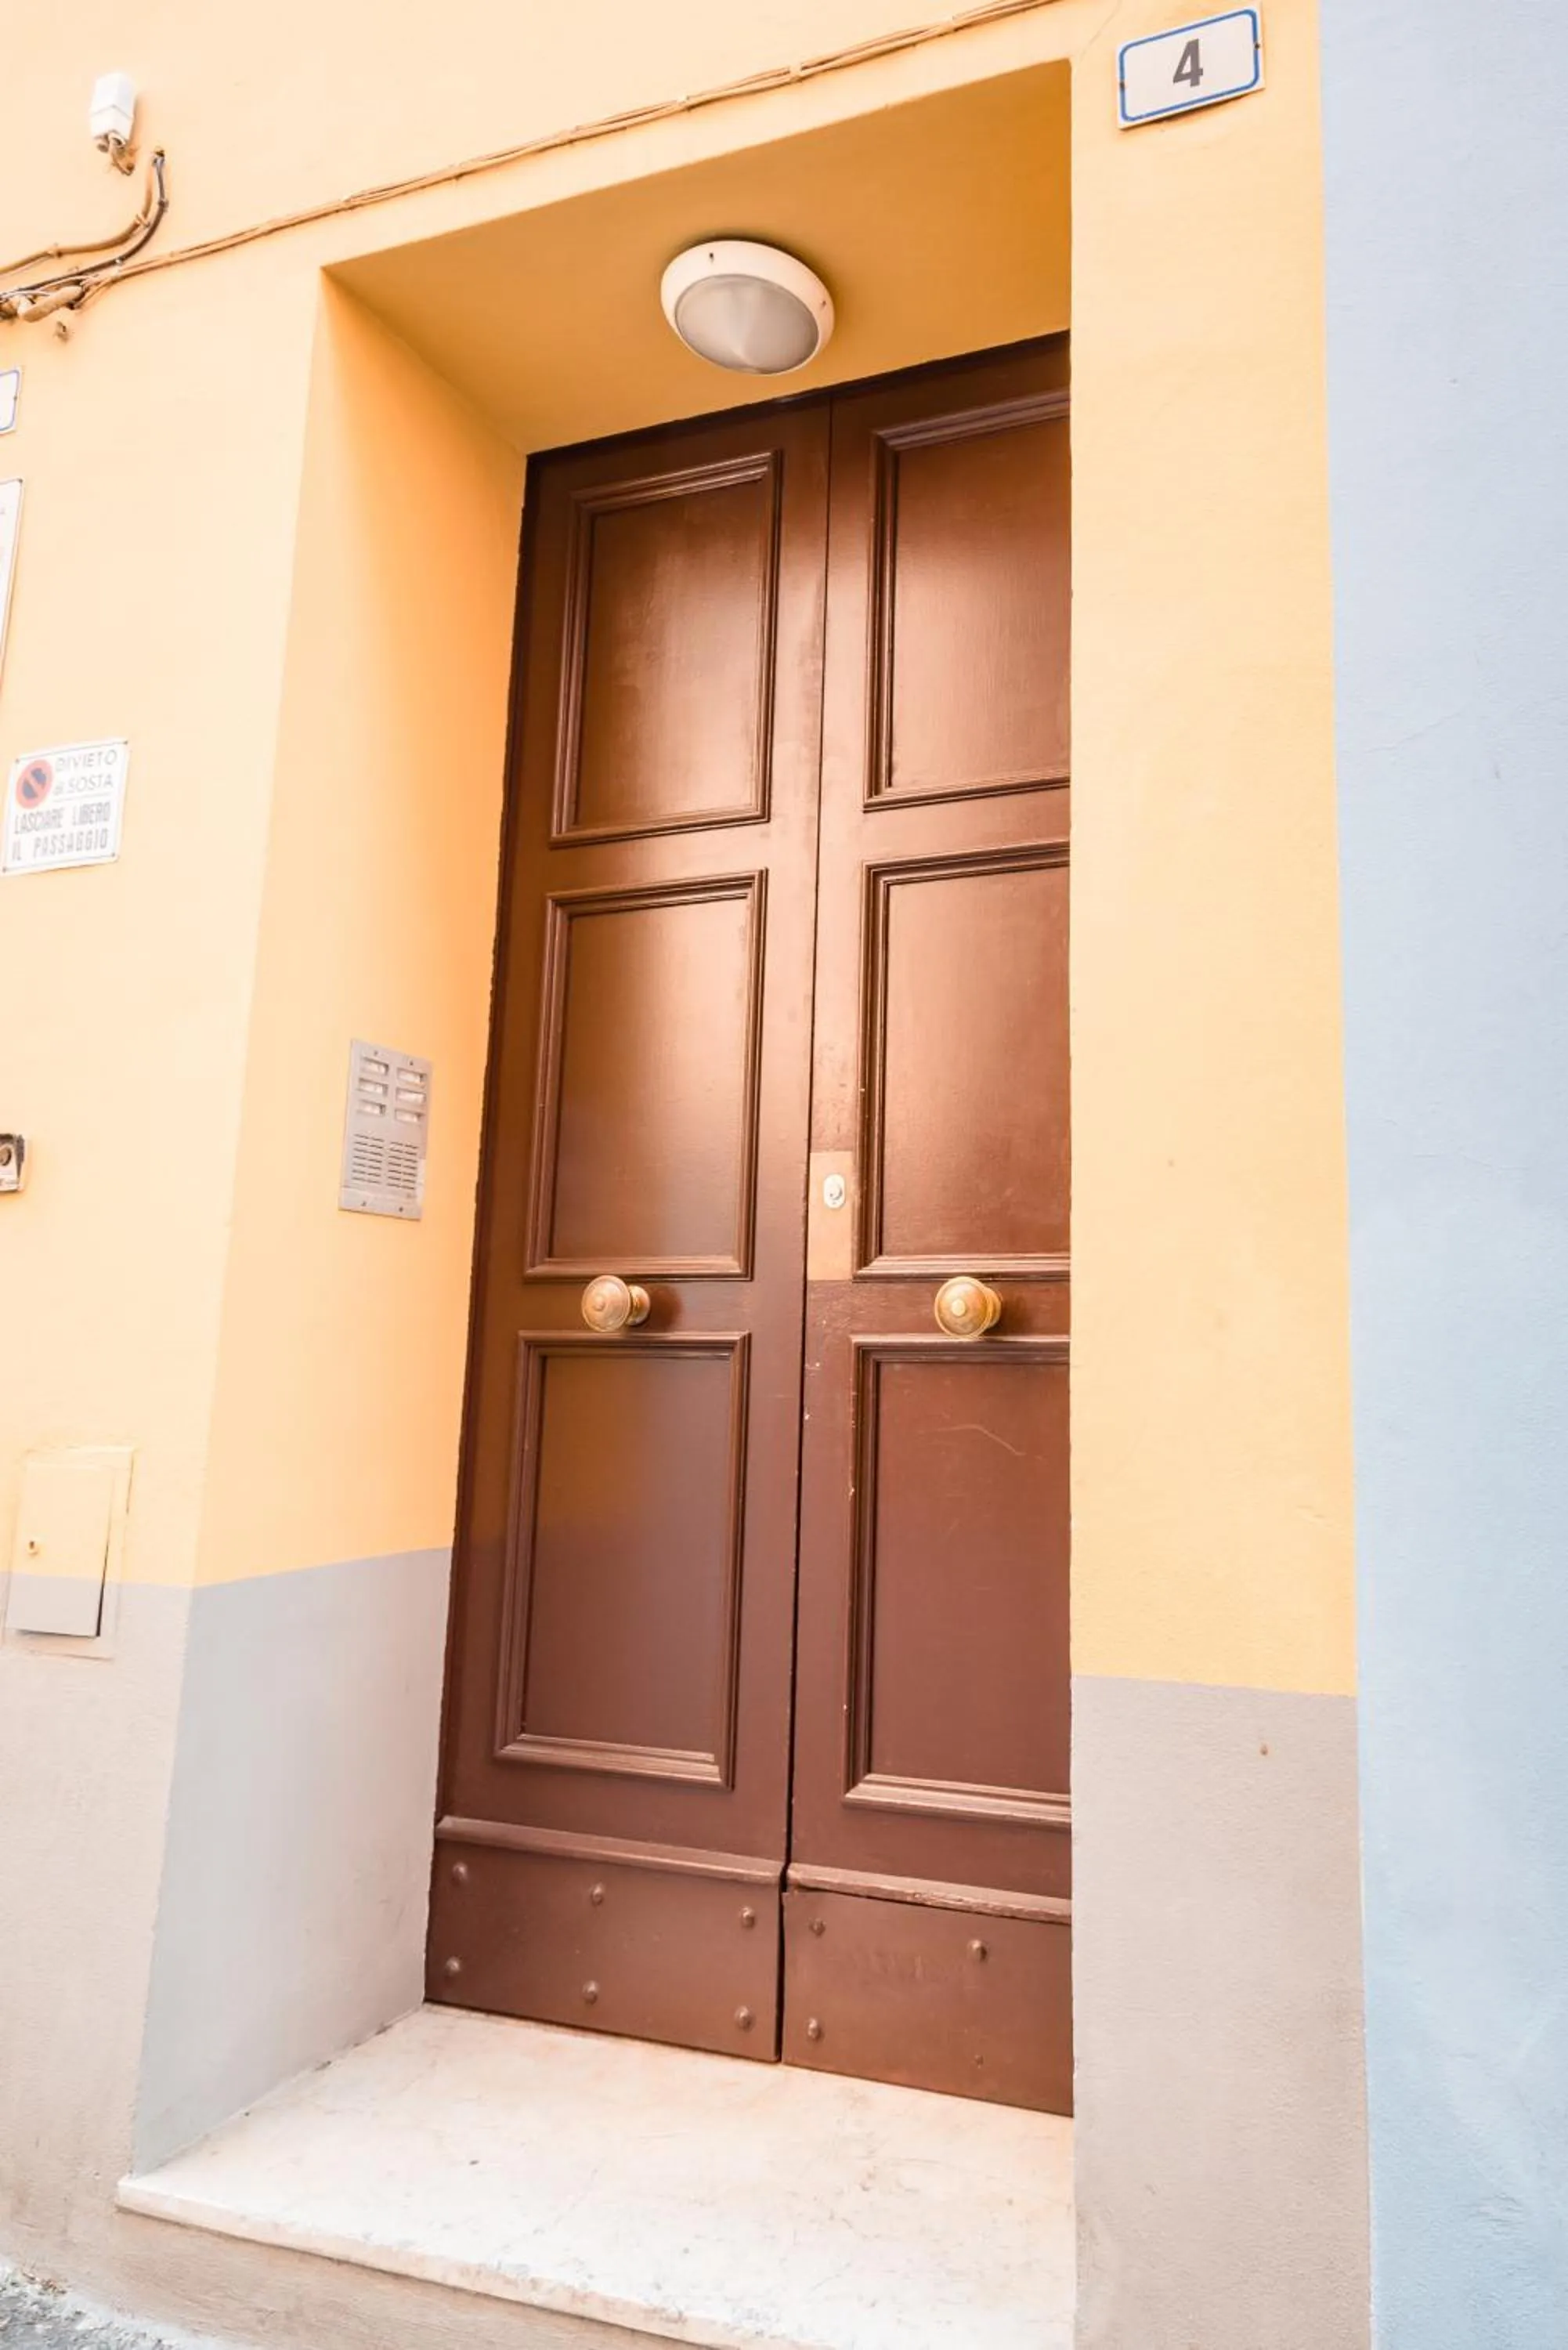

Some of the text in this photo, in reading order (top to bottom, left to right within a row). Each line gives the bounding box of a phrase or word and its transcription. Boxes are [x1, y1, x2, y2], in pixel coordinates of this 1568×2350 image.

[1172, 38, 1204, 87] 4
[55, 750, 117, 772] DIVIETO
[67, 774, 114, 794] SOSTA
[14, 802, 110, 834] LASCIARE LIBERO
[12, 828, 108, 860] IL PASSAGGIO
